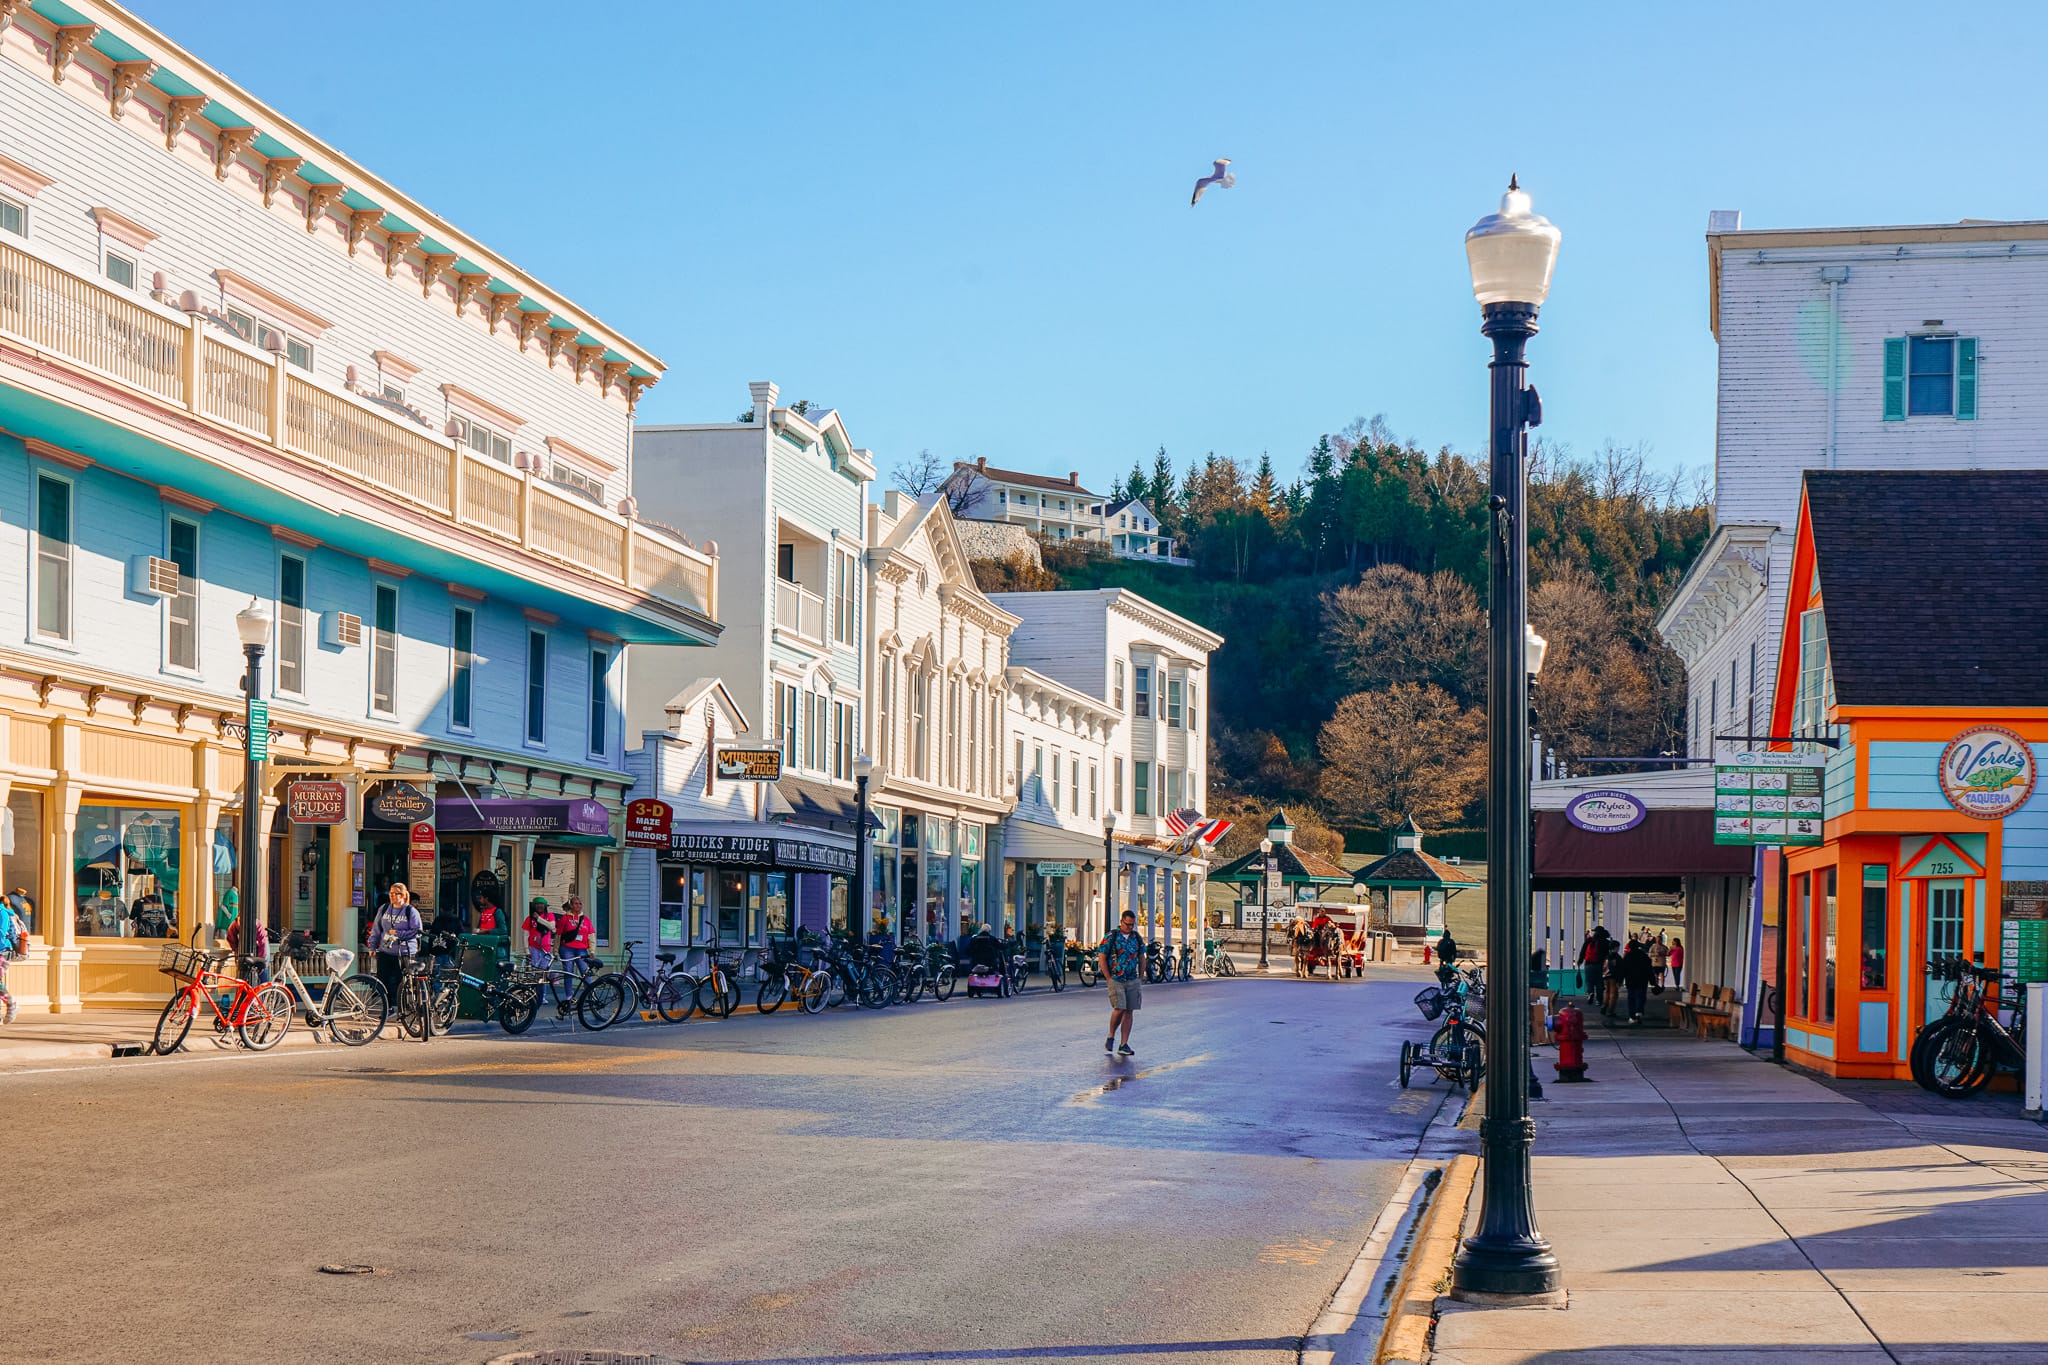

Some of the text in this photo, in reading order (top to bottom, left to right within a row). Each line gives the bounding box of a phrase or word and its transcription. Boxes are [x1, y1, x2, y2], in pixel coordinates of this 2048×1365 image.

[719, 751, 779, 767] MURDICK'S
[745, 763, 778, 774] FUDGE
[294, 791, 342, 801] MURRAY'S
[1965, 794, 2011, 805] TAQUERIA
[297, 800, 342, 816] FUDGE
[379, 799, 426, 811] Art Gallery
[635, 803, 664, 817] 3-D
[489, 816, 559, 826] MURRAY HOTEL
[636, 817, 660, 826] MAZE
[627, 831, 668, 841] MIRRORS
[672, 835, 724, 850] URDICKS
[731, 838, 770, 851] FUDGE
[1931, 862, 1954, 874] 7255
